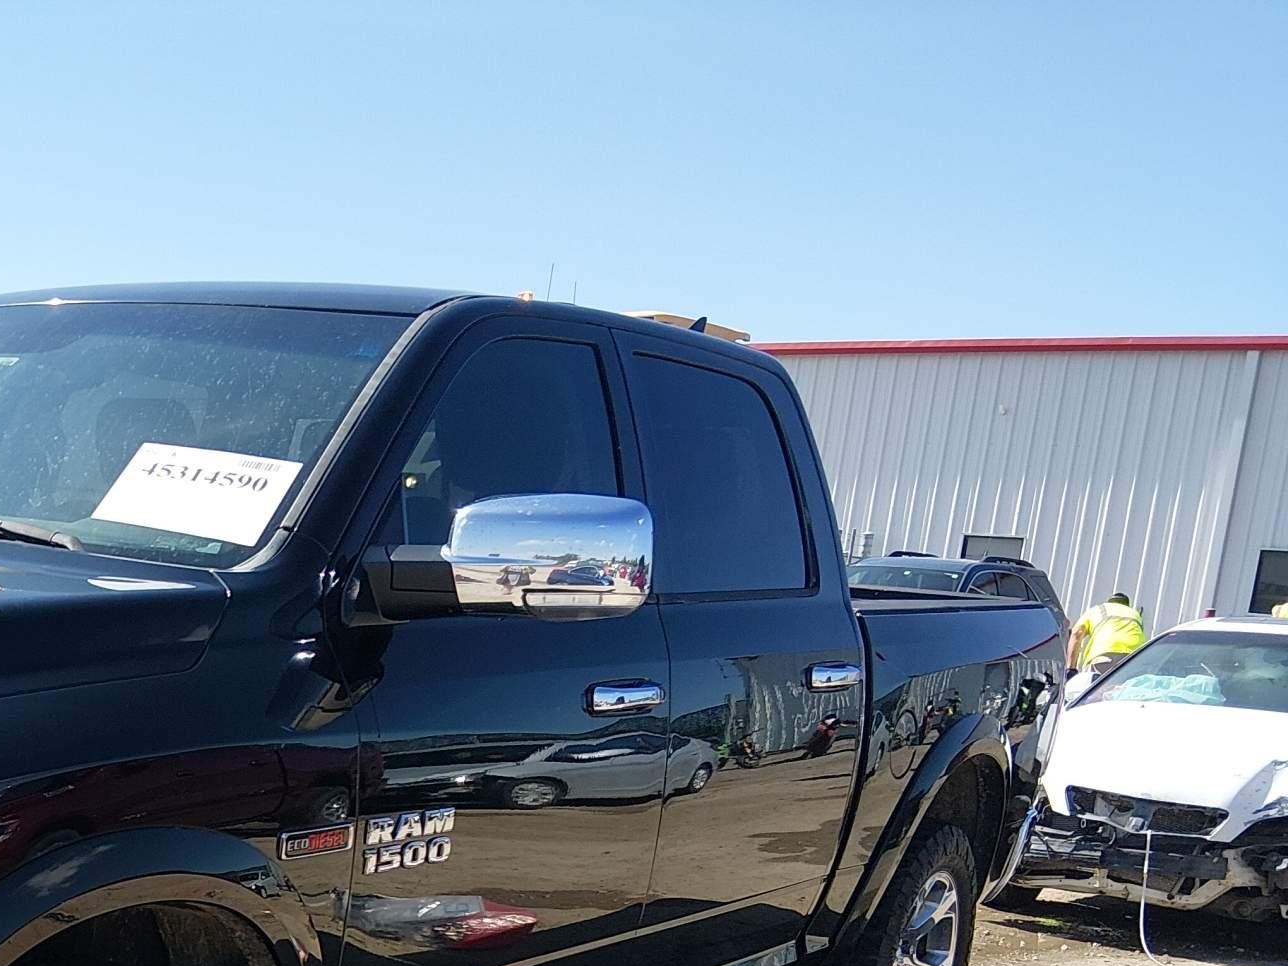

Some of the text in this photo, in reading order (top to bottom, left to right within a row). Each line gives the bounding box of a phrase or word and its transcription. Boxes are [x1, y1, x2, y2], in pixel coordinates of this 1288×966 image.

[142, 462, 269, 493] 45314590
[366, 807, 456, 845] RAM
[363, 836, 451, 875] 1500
